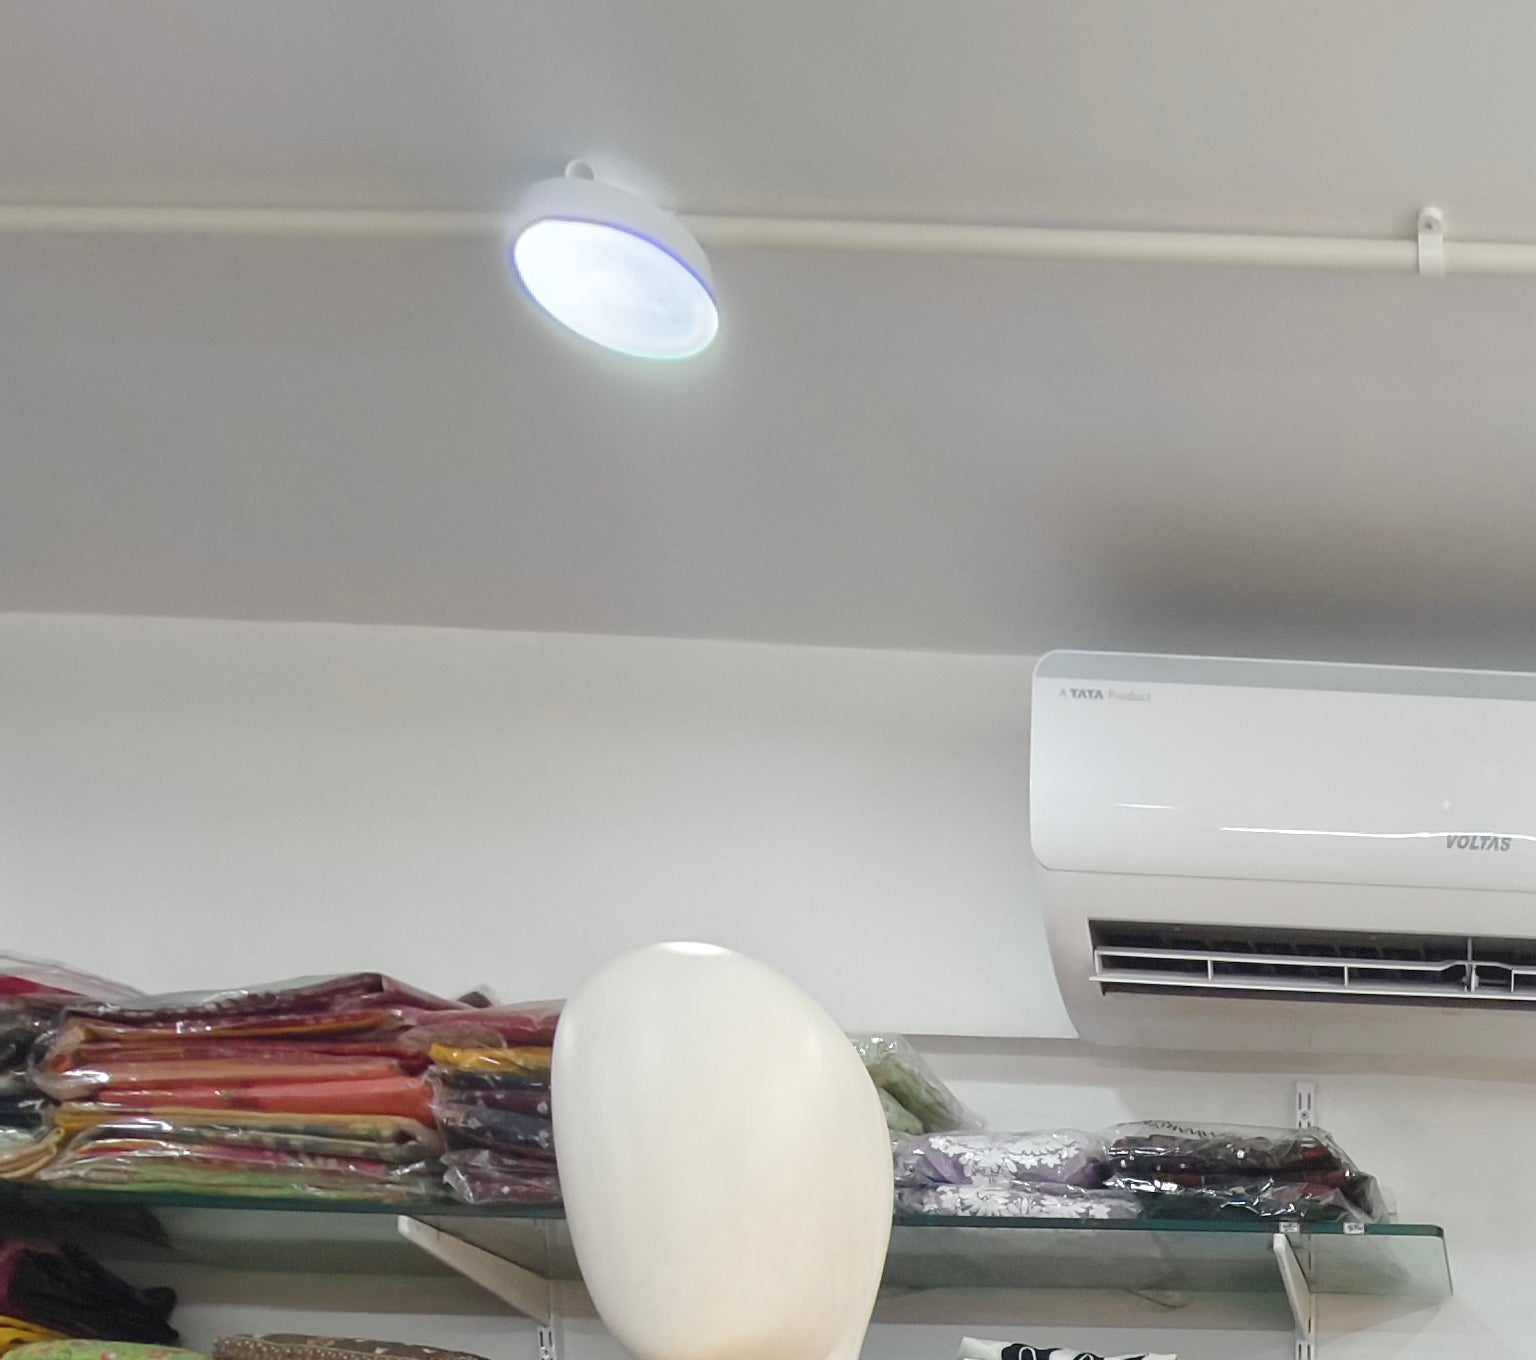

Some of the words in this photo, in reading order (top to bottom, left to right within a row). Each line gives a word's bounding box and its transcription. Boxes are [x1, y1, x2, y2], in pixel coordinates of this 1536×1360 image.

[1069, 688, 1104, 700] TATA
[1108, 688, 1151, 702] Product
[1446, 835, 1512, 852] VOLTAS
